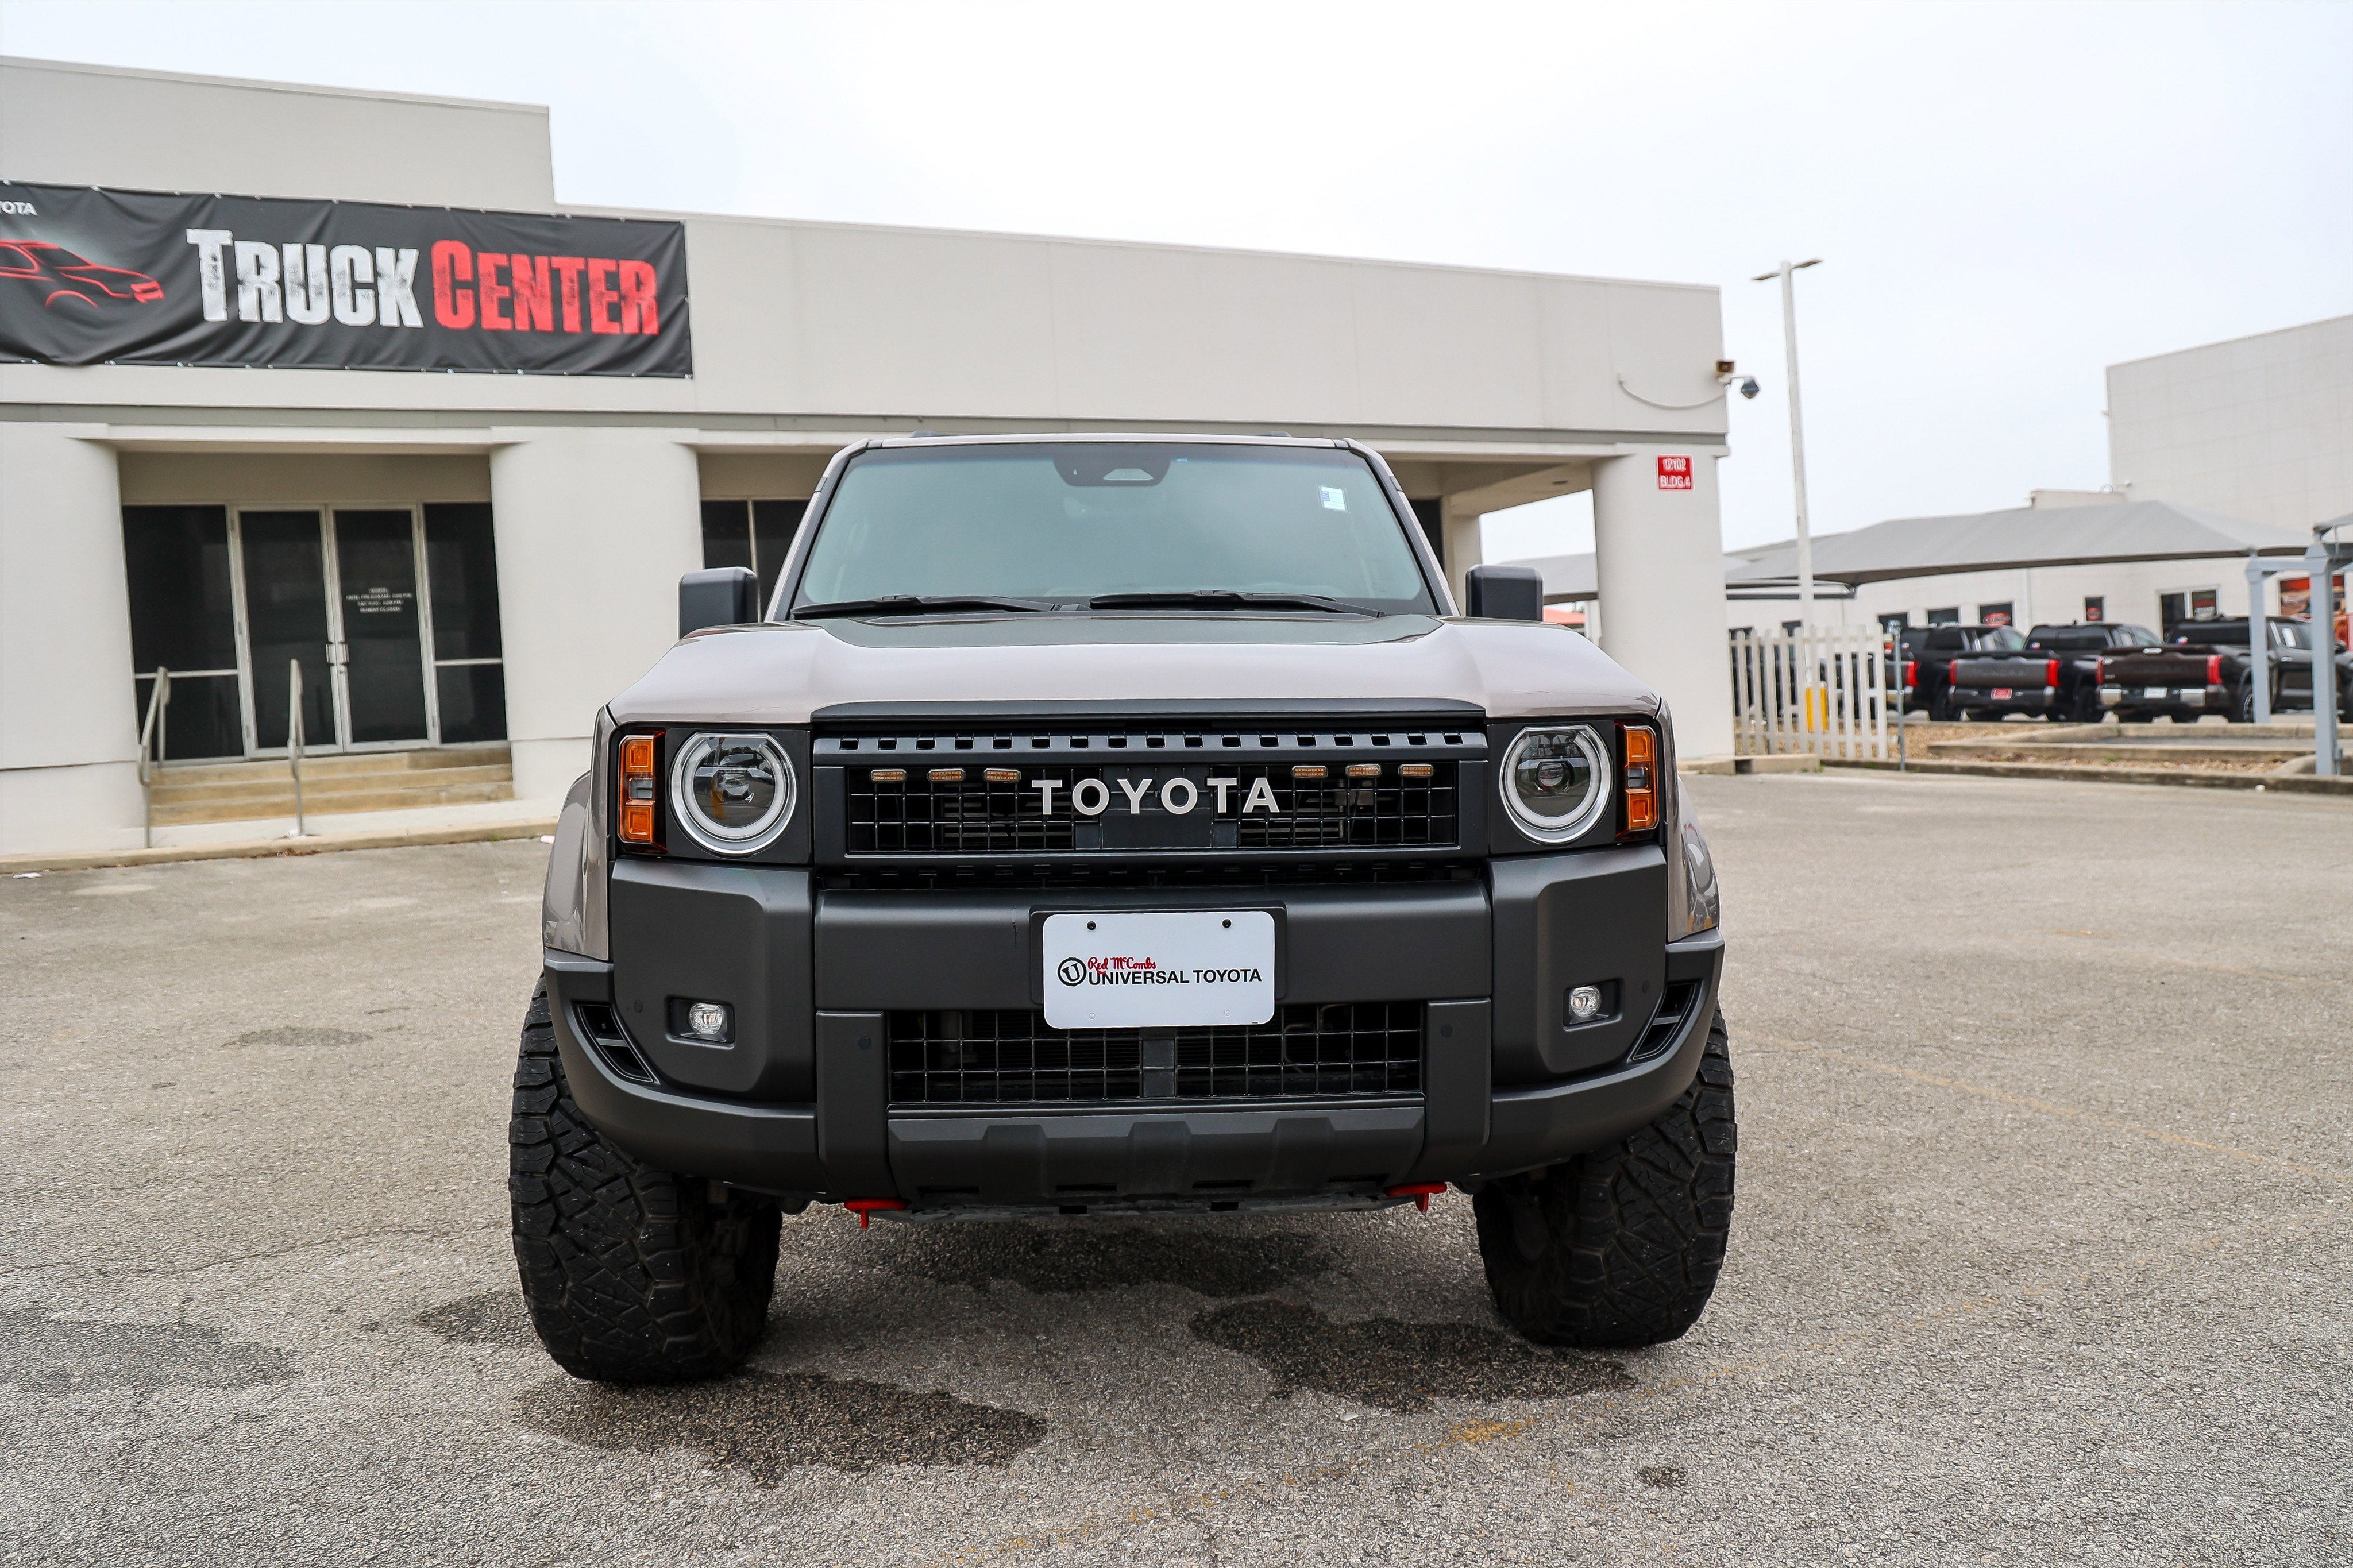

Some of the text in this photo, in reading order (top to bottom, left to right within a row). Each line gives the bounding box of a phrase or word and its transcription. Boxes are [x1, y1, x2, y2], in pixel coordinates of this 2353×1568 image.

[0, 201, 38, 215] OTA
[186, 228, 660, 335] TRUCK CENTER
[1032, 778, 1280, 816] TOYOTA
[1087, 956, 1156, 974] Red McCombs
[1089, 968, 1262, 985] UNIVERSAL TOYOTA
